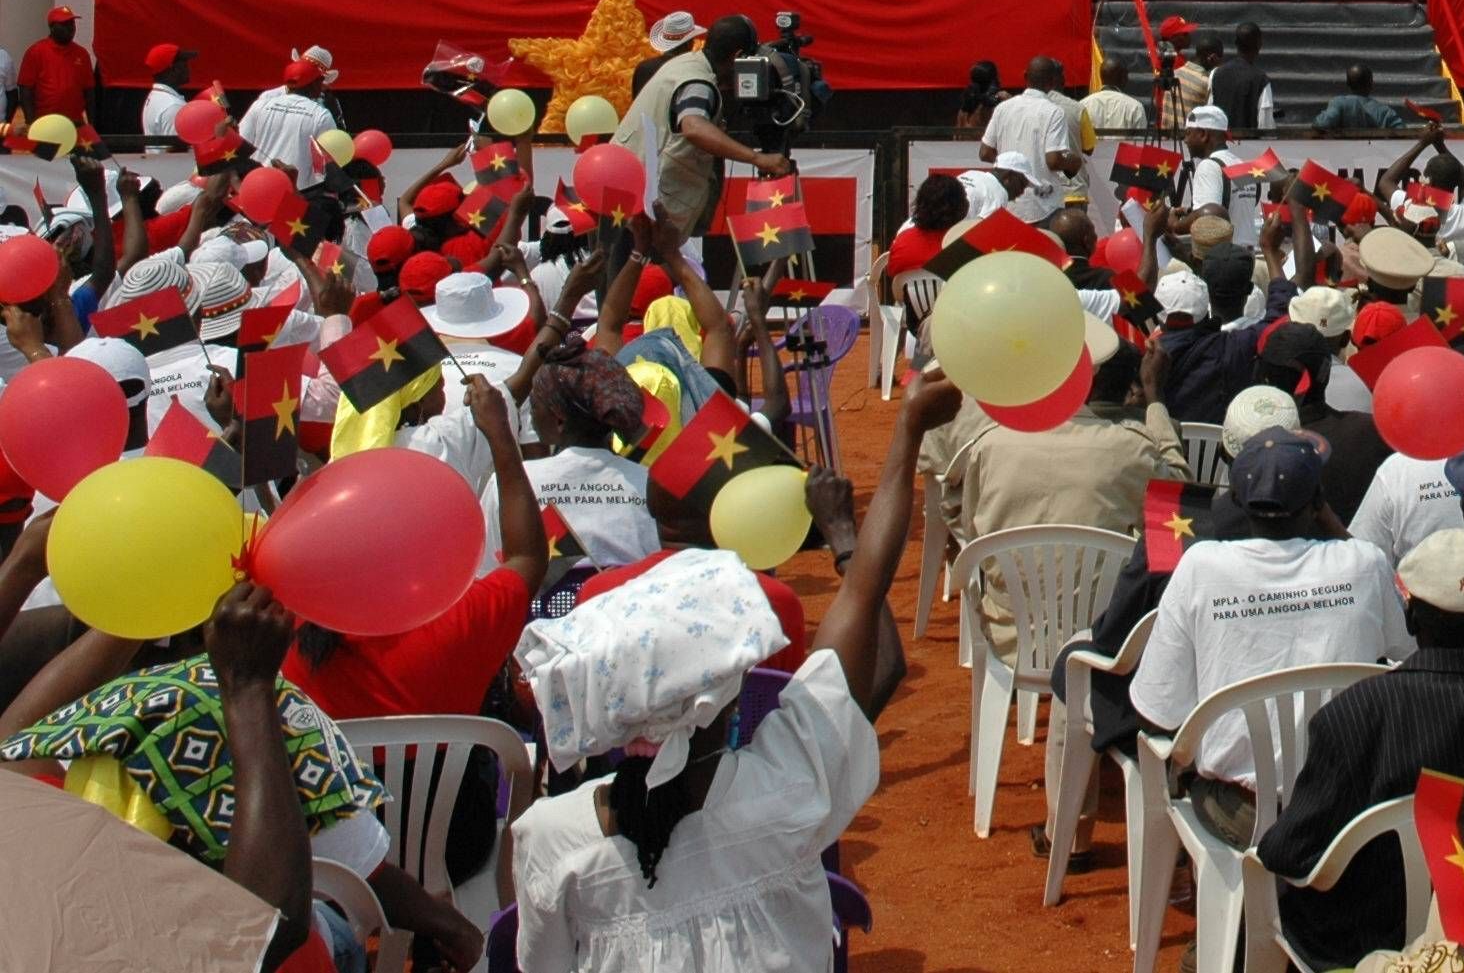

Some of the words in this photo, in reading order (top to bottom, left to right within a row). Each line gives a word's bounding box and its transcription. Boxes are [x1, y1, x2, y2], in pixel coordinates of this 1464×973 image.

[541, 483, 570, 492] MPLA
[580, 483, 624, 492] ANGOLA
[575, 496, 602, 505] PARA
[1213, 596, 1239, 607] MPLA
[1248, 592, 1256, 603] O
[1259, 589, 1308, 602] CAMINHO
[1311, 582, 1352, 596] SEGURO
[1213, 609, 1238, 621] PARA
[1241, 607, 1264, 618] UMA
[1267, 601, 1311, 616] ANGOLA
[1313, 596, 1355, 610] MELHOR
